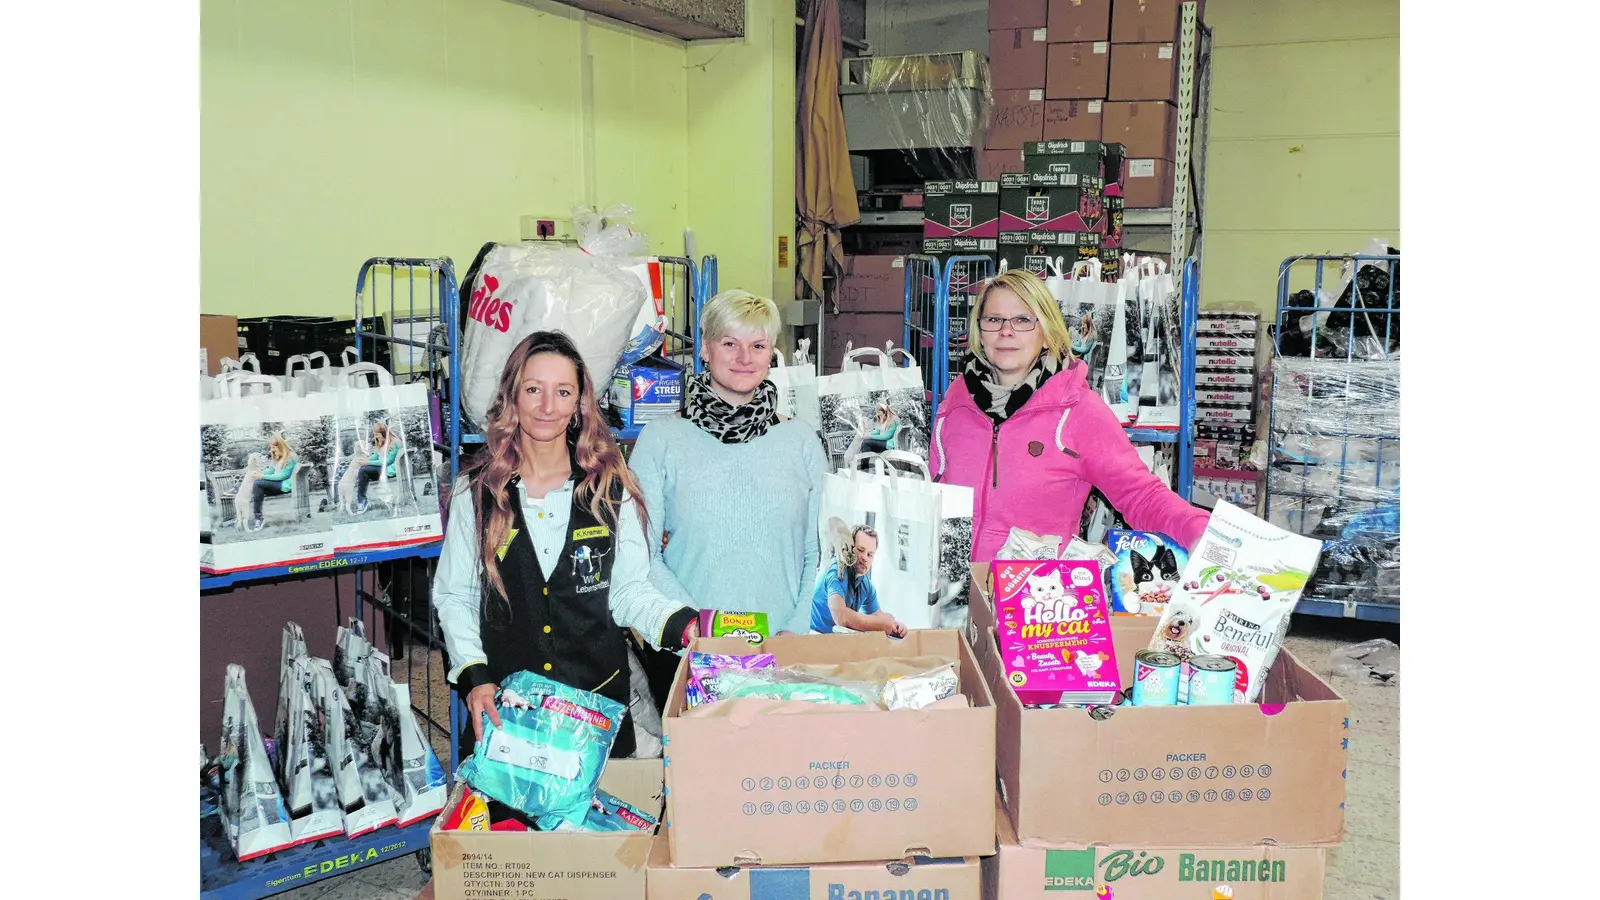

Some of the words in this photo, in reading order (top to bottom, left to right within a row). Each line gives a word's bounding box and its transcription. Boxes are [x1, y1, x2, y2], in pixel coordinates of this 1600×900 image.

[1033, 173, 1058, 181] Chipsfrisch
[955, 182, 979, 190] Chipsfrisch
[1031, 232, 1056, 241] Chipsfrisch
[954, 239, 977, 247] Chipsfrisch
[654, 386, 681, 395] STREU
[1205, 410, 1233, 418] nutella
[1115, 535, 1148, 554] felix
[288, 564, 317, 573] Eigentum
[319, 559, 349, 569] EDEKA
[349, 556, 368, 564] 12-17
[1024, 600, 1089, 625] Hello
[723, 616, 753, 626] BONZO
[1021, 624, 1054, 639] my
[1057, 620, 1092, 636] cat
[1214, 616, 1274, 649] Beneful
[1028, 639, 1088, 651] KNUSPERMENÜ
[1221, 642, 1249, 657] ORIGINAL
[1031, 652, 1055, 660] Beauty
[1038, 659, 1061, 667] Zusatz
[560, 684, 601, 711] ONE
[529, 756, 547, 767] ONE
[1166, 753, 1207, 762] PACKER
[809, 761, 850, 770] PACKER
[265, 873, 301, 888] Eigentum
[303, 847, 379, 879] EDEKA
[462, 862, 483, 870] ITEM
[505, 862, 531, 870] RT002
[1099, 849, 1165, 882] Bio
[1178, 853, 1286, 882] Bananen
[464, 880, 504, 888] QTY/CTN:
[505, 880, 515, 888] 30
[517, 880, 535, 888] PCS
[1045, 877, 1095, 886] EDEKA
